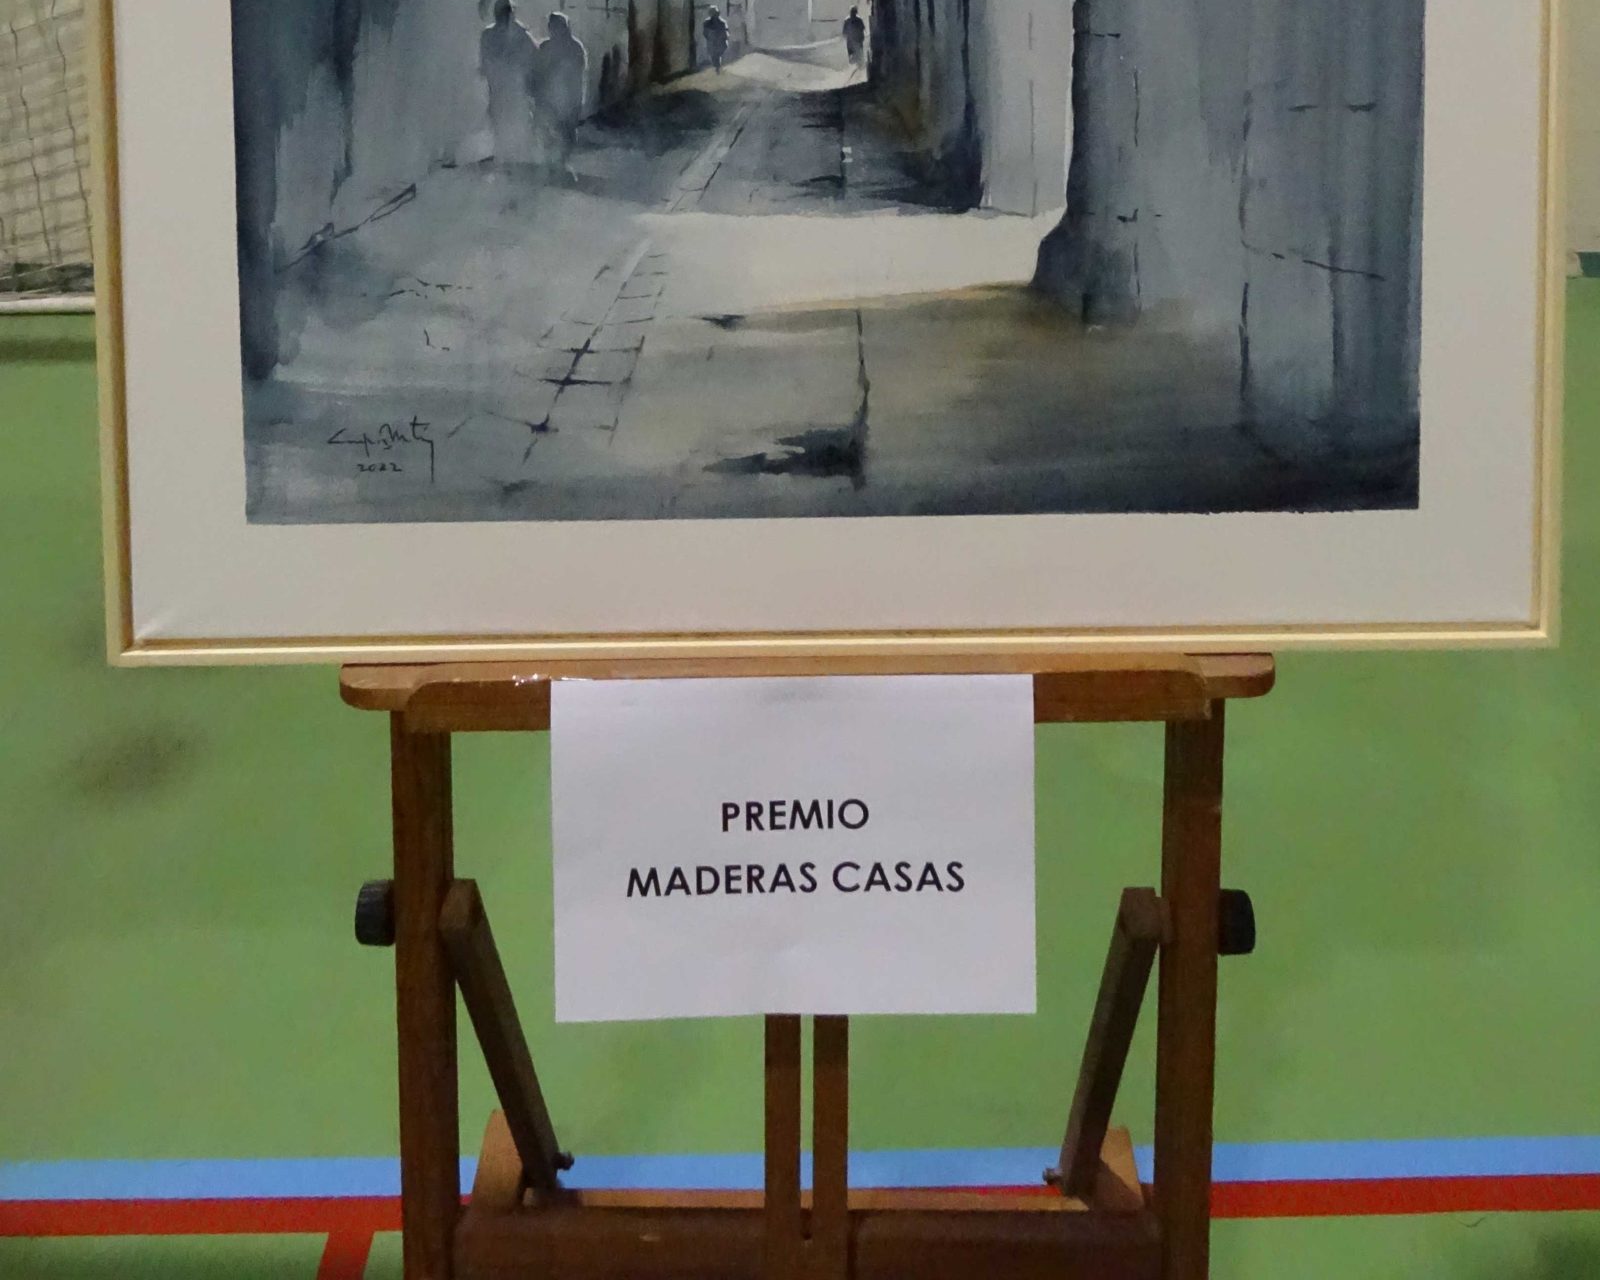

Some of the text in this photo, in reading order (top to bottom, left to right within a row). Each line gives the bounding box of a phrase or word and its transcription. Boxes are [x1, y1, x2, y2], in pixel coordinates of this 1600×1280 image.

[722, 798, 870, 832] PREMIO
[626, 861, 966, 898] MADERAS CASAS
